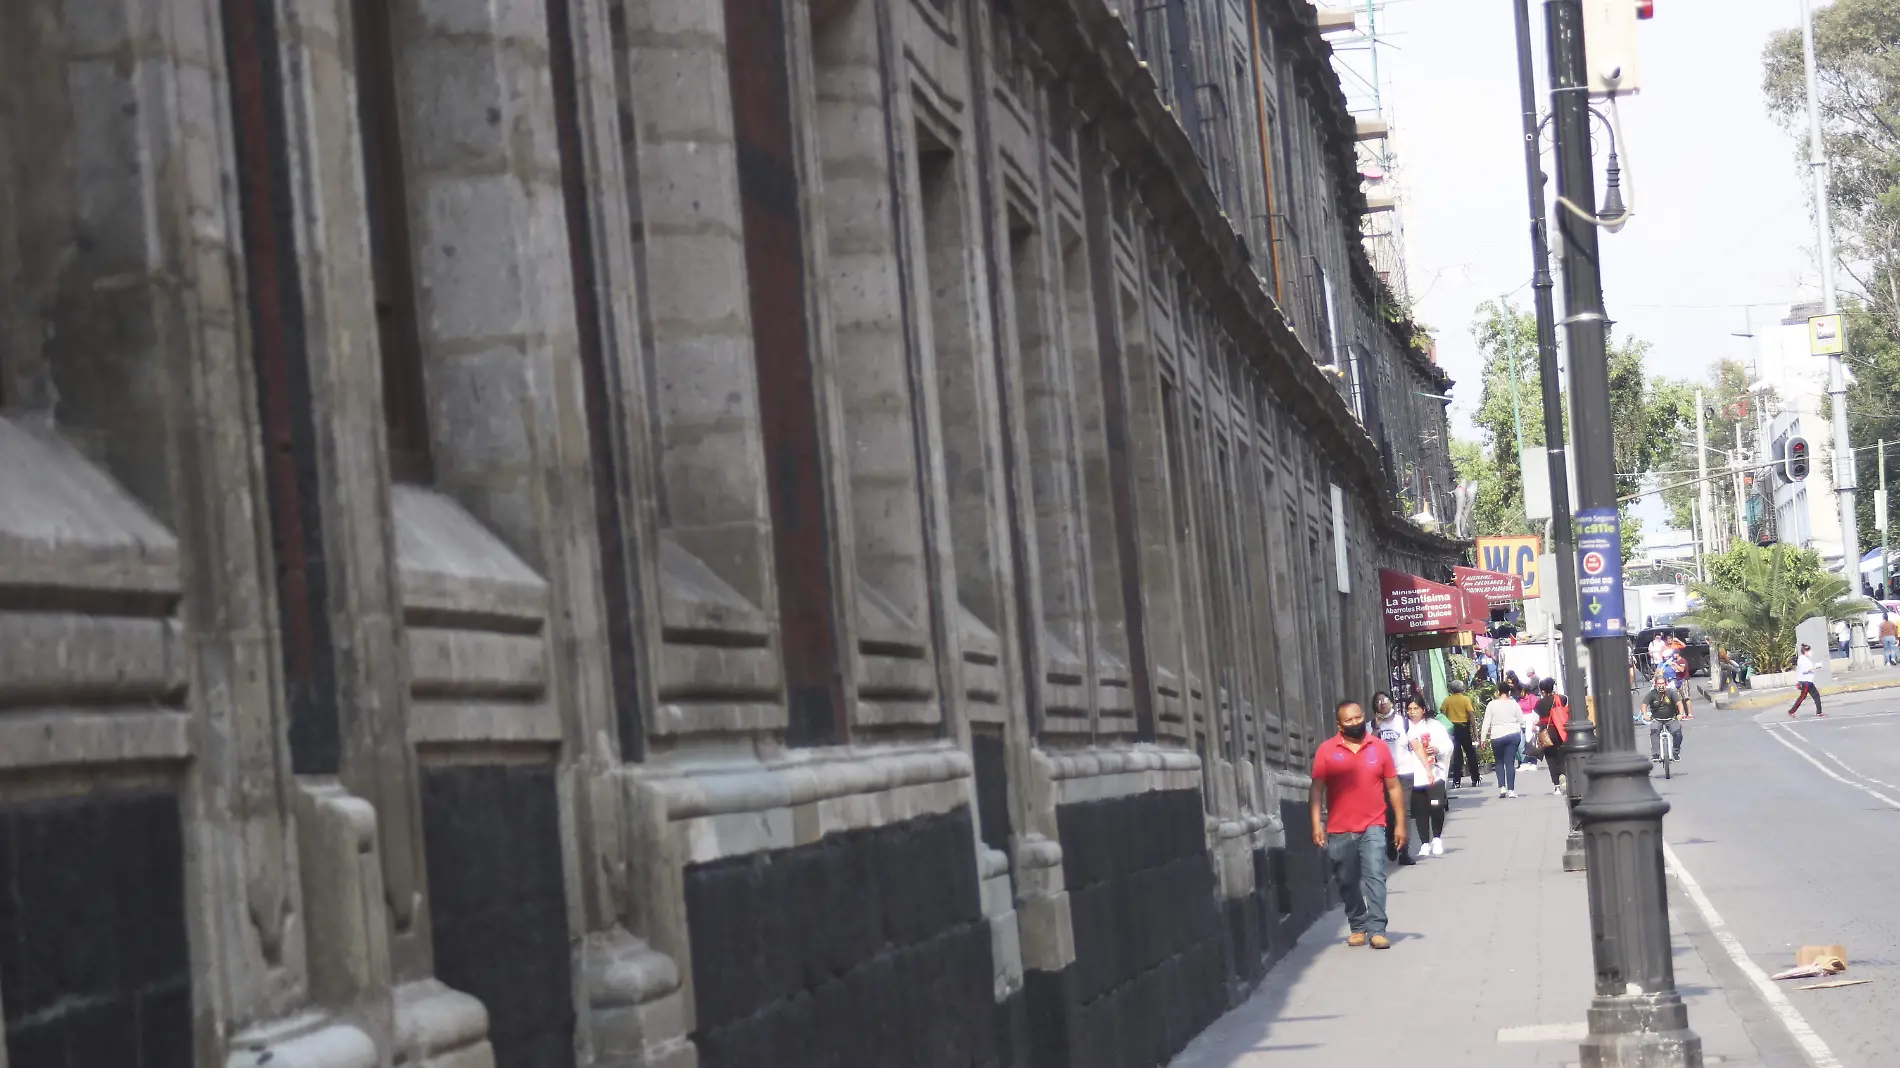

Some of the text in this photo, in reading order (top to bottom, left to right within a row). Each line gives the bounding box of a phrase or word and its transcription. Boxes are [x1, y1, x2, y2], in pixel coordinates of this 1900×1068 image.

[1483, 545, 1535, 589] WC
[1391, 588, 1430, 596] Minisuper
[1385, 598, 1399, 607] La
[1386, 603, 1452, 614] Abarrotes Refrescos
[1394, 610, 1452, 621] Cerveza Dulces
[1409, 619, 1440, 628] Botanas
